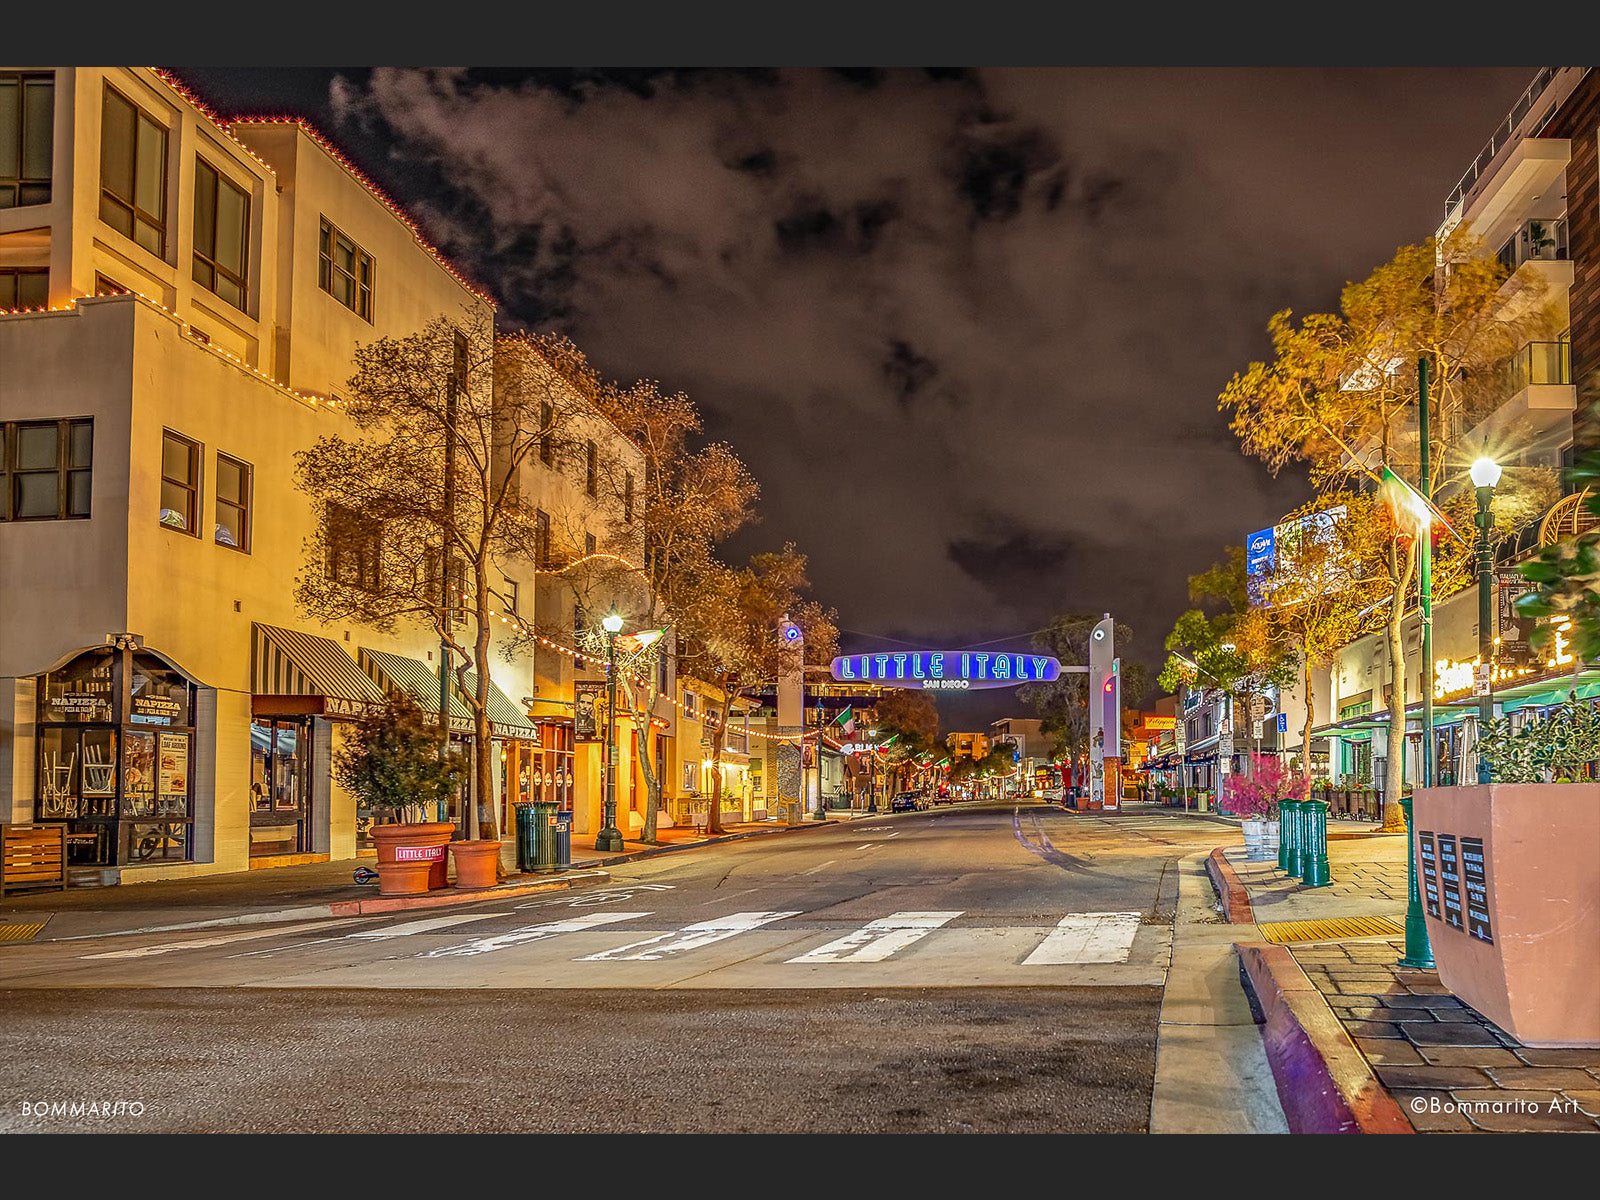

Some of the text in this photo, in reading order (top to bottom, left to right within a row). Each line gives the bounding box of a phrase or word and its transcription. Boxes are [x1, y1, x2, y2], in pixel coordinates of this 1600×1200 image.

[841, 653, 1048, 678] LITTLE ITALY
[923, 680, 969, 690] SAN DIEGO
[51, 698, 107, 706] NAPIZZA
[135, 698, 181, 710] NAPIZZA
[494, 723, 537, 740] NAPIZZA
[398, 847, 443, 858] LITTLE ITALY
